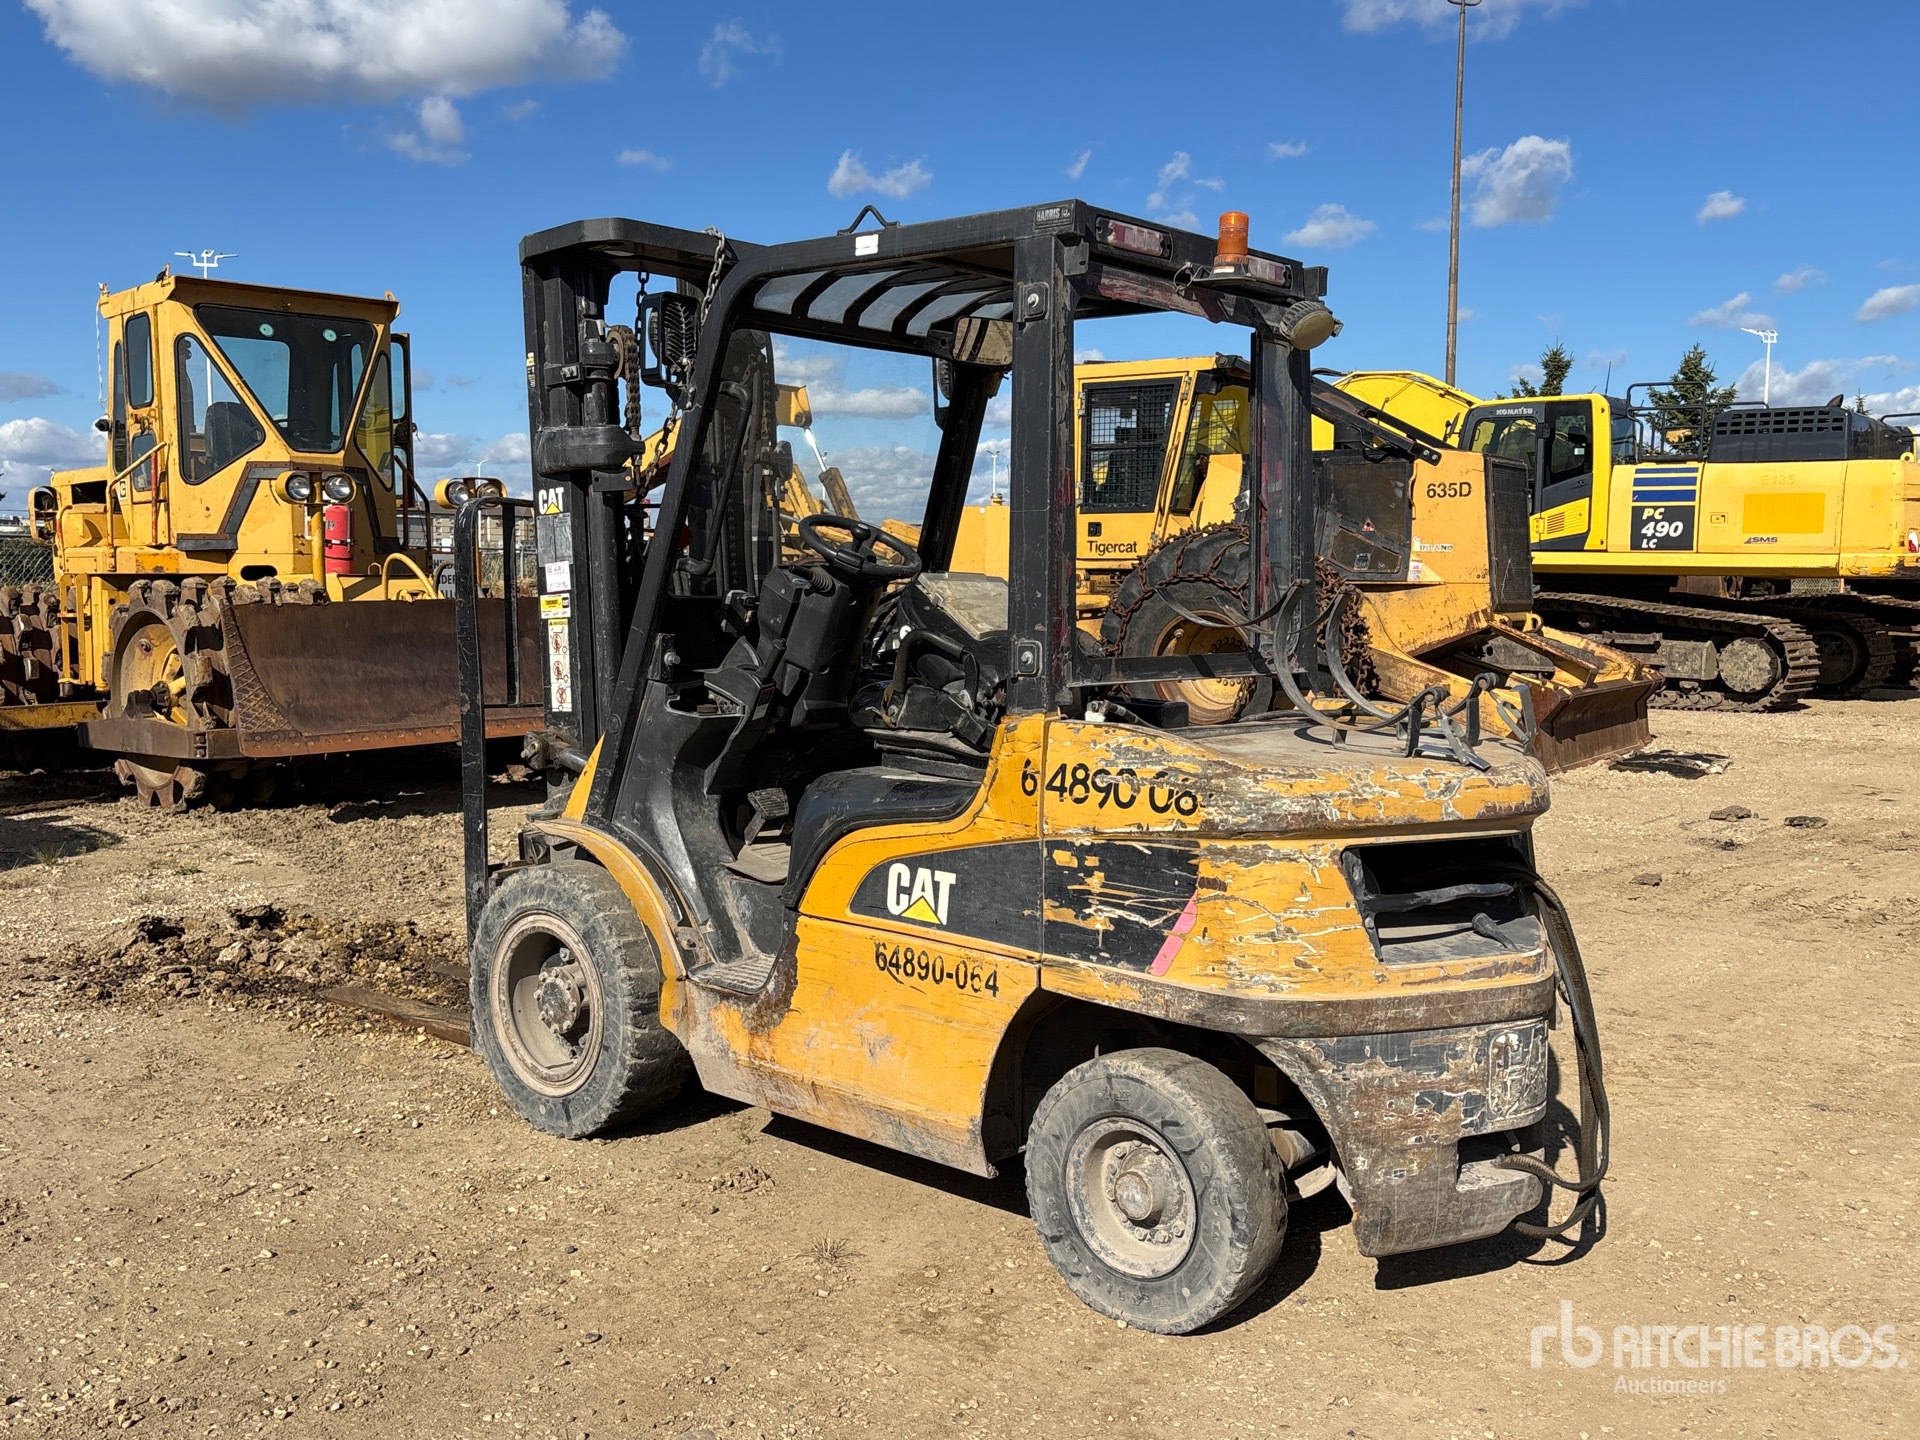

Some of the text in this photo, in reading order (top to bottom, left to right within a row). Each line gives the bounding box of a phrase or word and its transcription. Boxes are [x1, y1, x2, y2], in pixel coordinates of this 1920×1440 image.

[1496, 407, 1533, 415] KOMATSU
[1426, 481, 1472, 498] 635D
[538, 486, 564, 515] CAT
[1641, 507, 1665, 520] PC
[1640, 521, 1684, 537] 490
[1086, 540, 1138, 557] Tigercat
[1641, 538, 1658, 549] LC
[886, 862, 957, 926] CAT
[874, 941, 1000, 998] 64890-064
